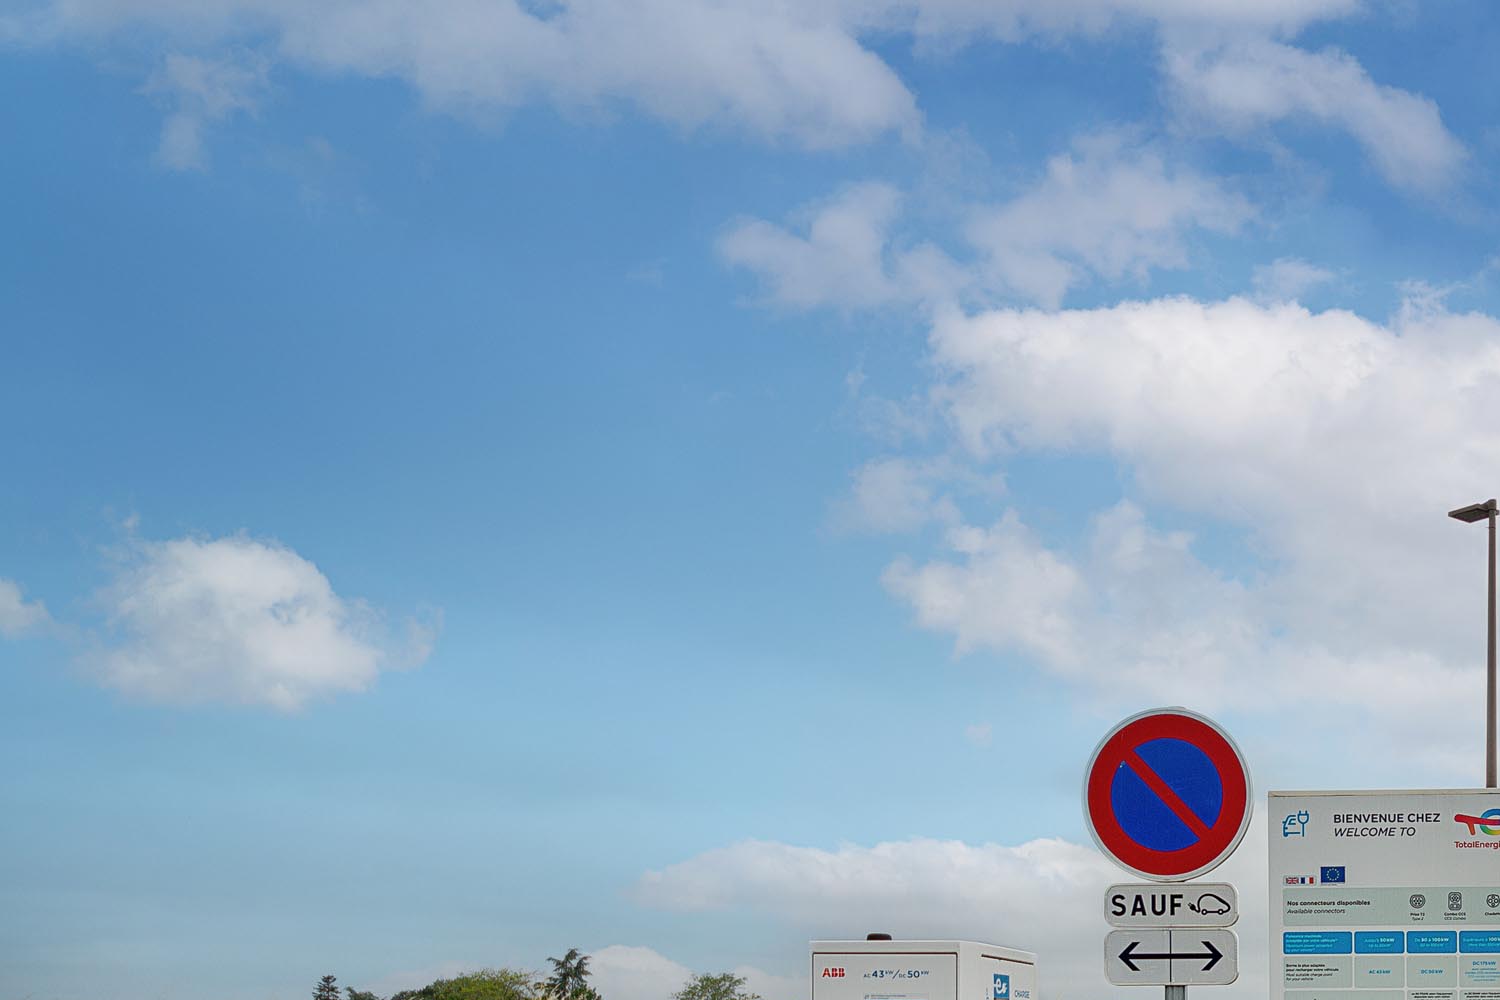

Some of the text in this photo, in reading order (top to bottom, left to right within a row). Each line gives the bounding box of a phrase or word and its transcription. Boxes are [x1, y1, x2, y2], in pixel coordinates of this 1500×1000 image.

[1333, 813, 1441, 823] BIENVENUE CHEZ
[1334, 827, 1416, 837] WELCOME TO
[1111, 894, 1183, 916] SAUF
[822, 968, 845, 978] ABB
[872, 970, 884, 978] 43
[907, 970, 920, 978] 50
